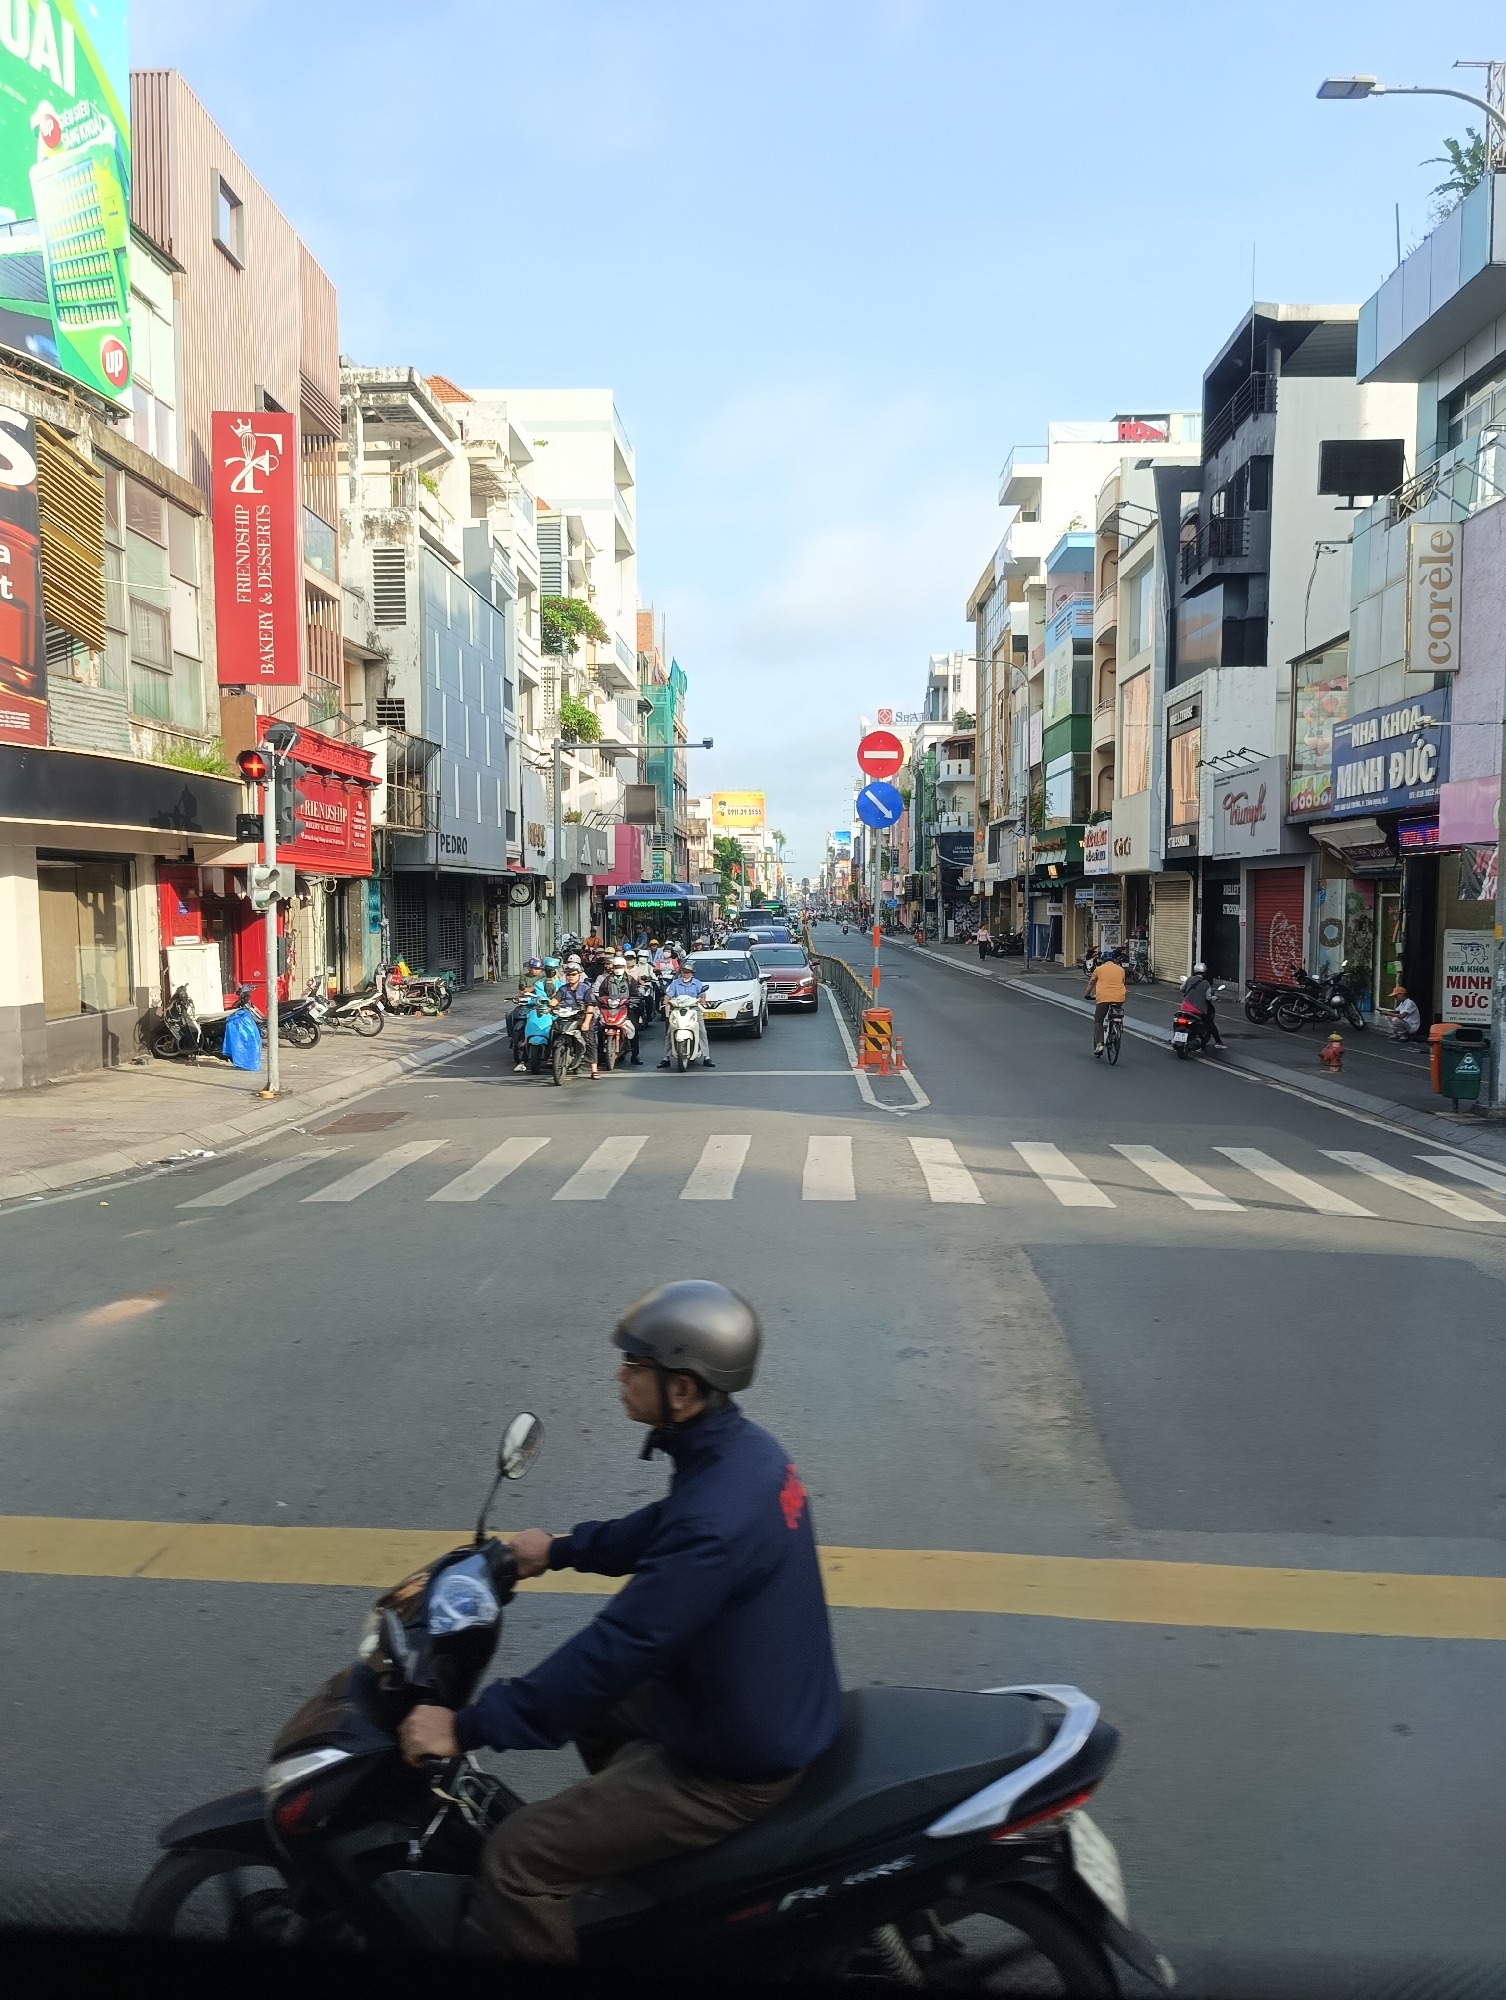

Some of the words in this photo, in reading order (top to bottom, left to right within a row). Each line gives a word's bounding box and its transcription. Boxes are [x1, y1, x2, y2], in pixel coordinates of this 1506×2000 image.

[234, 504, 252, 604] FRIENDSHIP
[255, 504, 273, 590] DESSERTS
[258, 591, 273, 605] &
[1418, 530, 1455, 665] corèle
[257, 608, 275, 675] BAKERY
[1351, 718, 1380, 749] NHA
[1380, 704, 1423, 741] KHOA
[1336, 755, 1385, 800] MINH
[1388, 733, 1437, 790] ĐỨC
[1222, 782, 1267, 837] Triumph
[440, 833, 468, 856] PEDRO
[1446, 975, 1492, 990] MINH
[1448, 965, 1465, 974] NHA
[1466, 965, 1490, 974] KHOA
[1450, 991, 1489, 1009] ĐỨC
